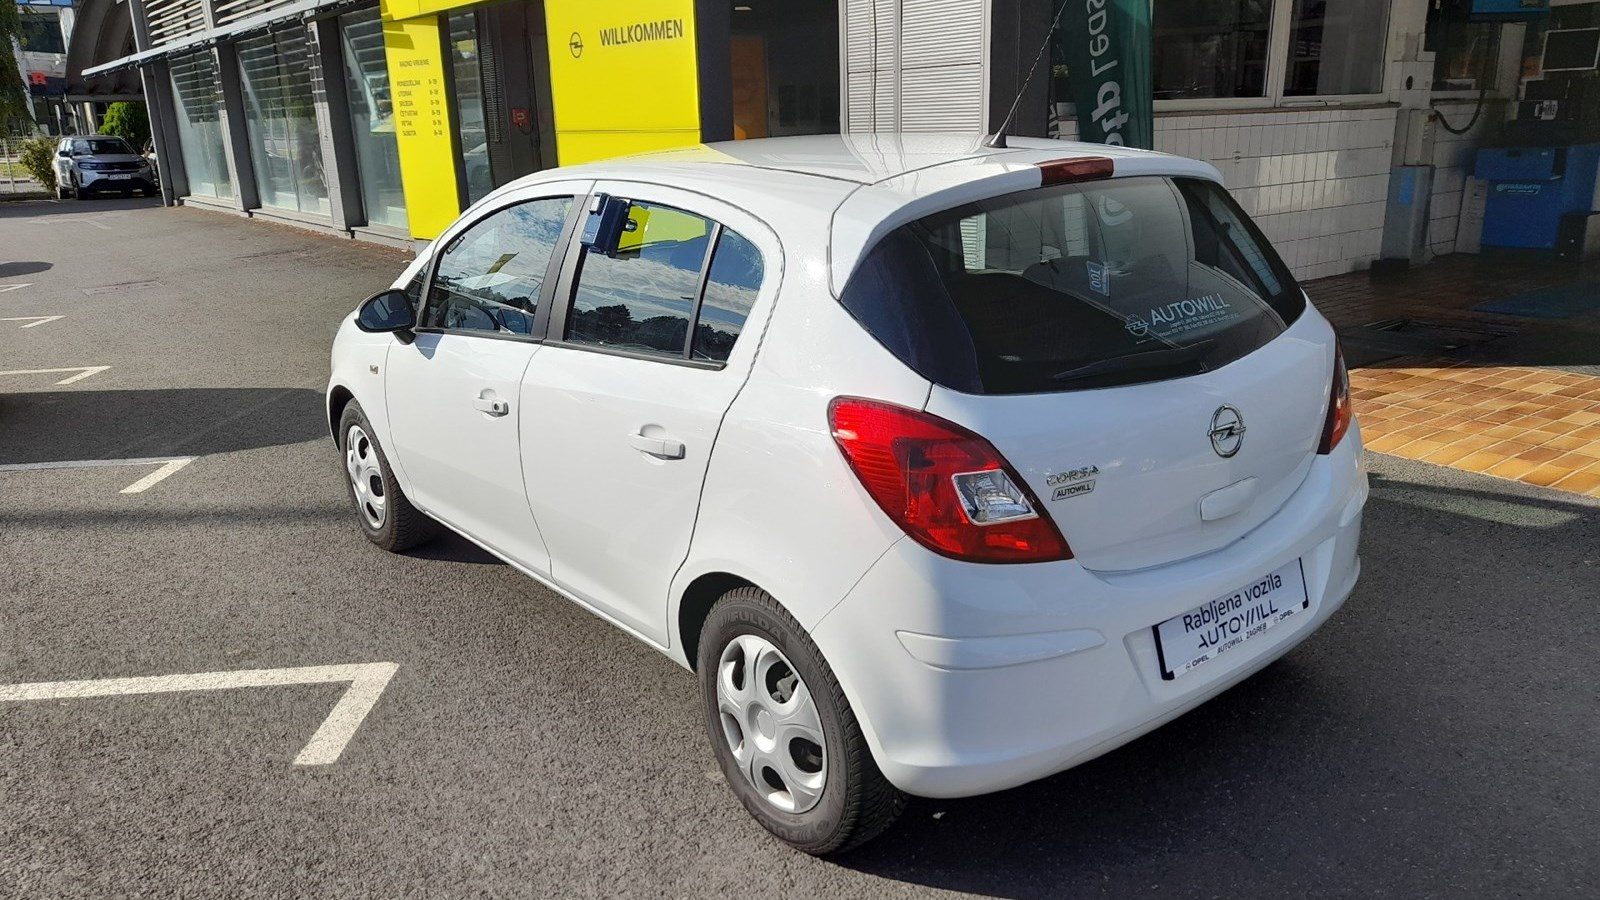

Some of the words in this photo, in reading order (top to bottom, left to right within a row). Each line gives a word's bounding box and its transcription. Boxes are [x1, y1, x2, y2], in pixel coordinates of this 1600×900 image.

[600, 18, 683, 46] WILLKOMMEN
[1150, 293, 1231, 326] AUTOWILL
[1046, 465, 1100, 486] CORSA
[1056, 484, 1092, 498] AUTOWILL
[1182, 594, 1242, 633] Rabljena
[1244, 573, 1282, 602] vozila
[1191, 654, 1210, 667] OPEL
[1217, 637, 1244, 655] AUTOWILL
[1246, 622, 1267, 640] ZAGREB
[1279, 609, 1295, 621] OPEL
[1198, 600, 1279, 649] AUTOWILL
